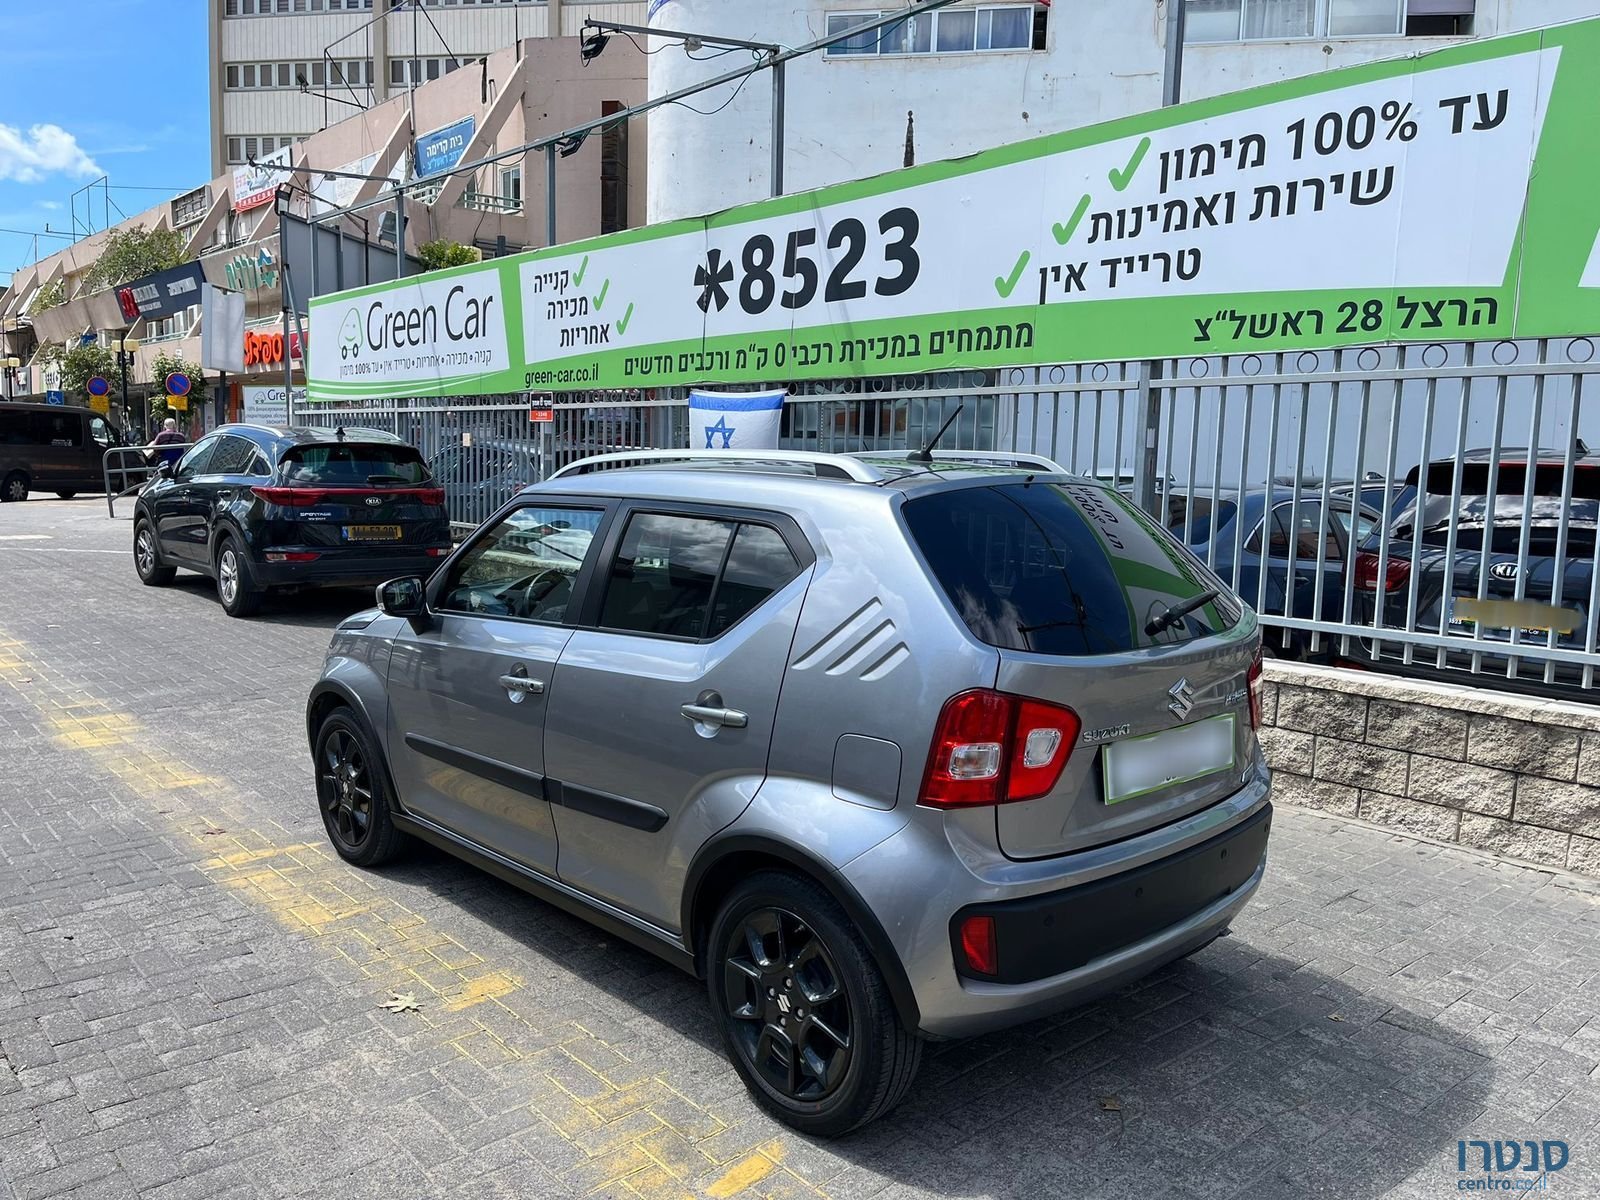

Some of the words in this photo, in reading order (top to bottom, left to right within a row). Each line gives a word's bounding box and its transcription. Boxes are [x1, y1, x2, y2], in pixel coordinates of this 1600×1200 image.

[1439, 89, 1508, 134] עד
[450, 134, 464, 149] בית
[1287, 101, 1417, 160] 100%
[1160, 134, 1265, 194] מימון
[1249, 166, 1394, 221] שירות
[1088, 191, 1235, 243] ואמינות
[1101, 248, 1201, 288] טרייד
[535, 270, 568, 295] קנייה
[1040, 262, 1088, 305] אין
[367, 302, 436, 351] Green
[445, 286, 492, 341] Car
[548, 297, 587, 319] מכירה
[1336, 300, 1382, 333] 28
[1397, 296, 1497, 328] הרצל
[560, 324, 609, 347] אחריות
[930, 323, 1032, 354] מתמחים
[446, 352, 468, 365] מכירה
[475, 350, 491, 366] קניה
[775, 343, 785, 367] 0
[792, 343, 832, 365] רכבי
[839, 334, 920, 362] במכירת
[355, 363, 371, 375] 100%
[383, 360, 393, 375] אין
[395, 358, 411, 371] טרייד
[416, 355, 440, 368] אחריות
[625, 356, 672, 375] חדשים
[679, 351, 729, 372] ורכבים
[524, 363, 598, 388] green-car.co.il
[1083, 723, 1130, 742] SUZUKI
